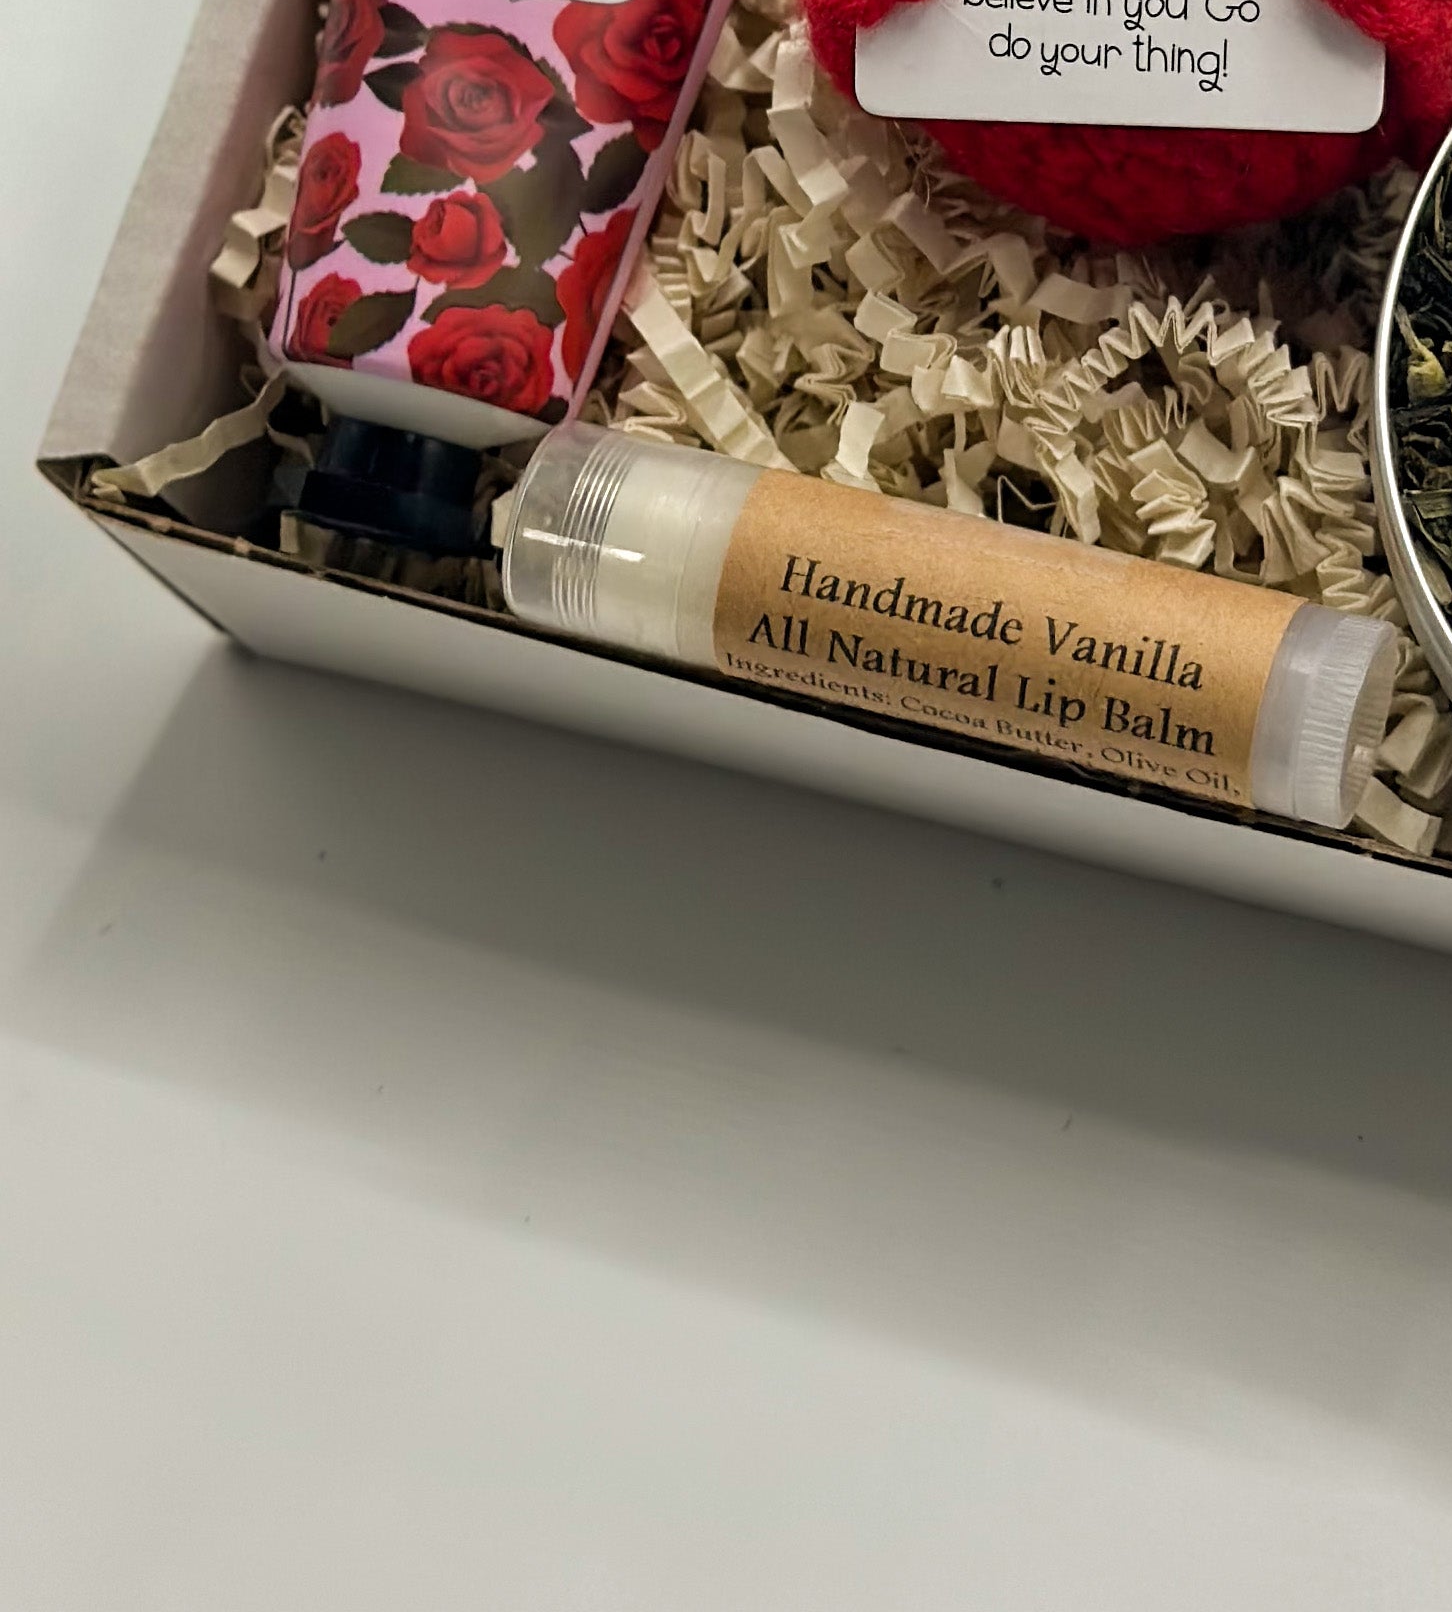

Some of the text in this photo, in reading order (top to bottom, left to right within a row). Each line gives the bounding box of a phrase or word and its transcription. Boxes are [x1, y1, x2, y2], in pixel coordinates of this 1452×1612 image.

[987, 22, 1230, 93] do your thing!
[747, 611, 1217, 757] All Natural Lip Balm
[778, 552, 1206, 692] Handmade Vanilla
[724, 650, 893, 708] Ingredients:
[898, 693, 988, 731] Cocoa
[1100, 745, 1179, 779] Olive
[1184, 765, 1243, 799] Oil,
